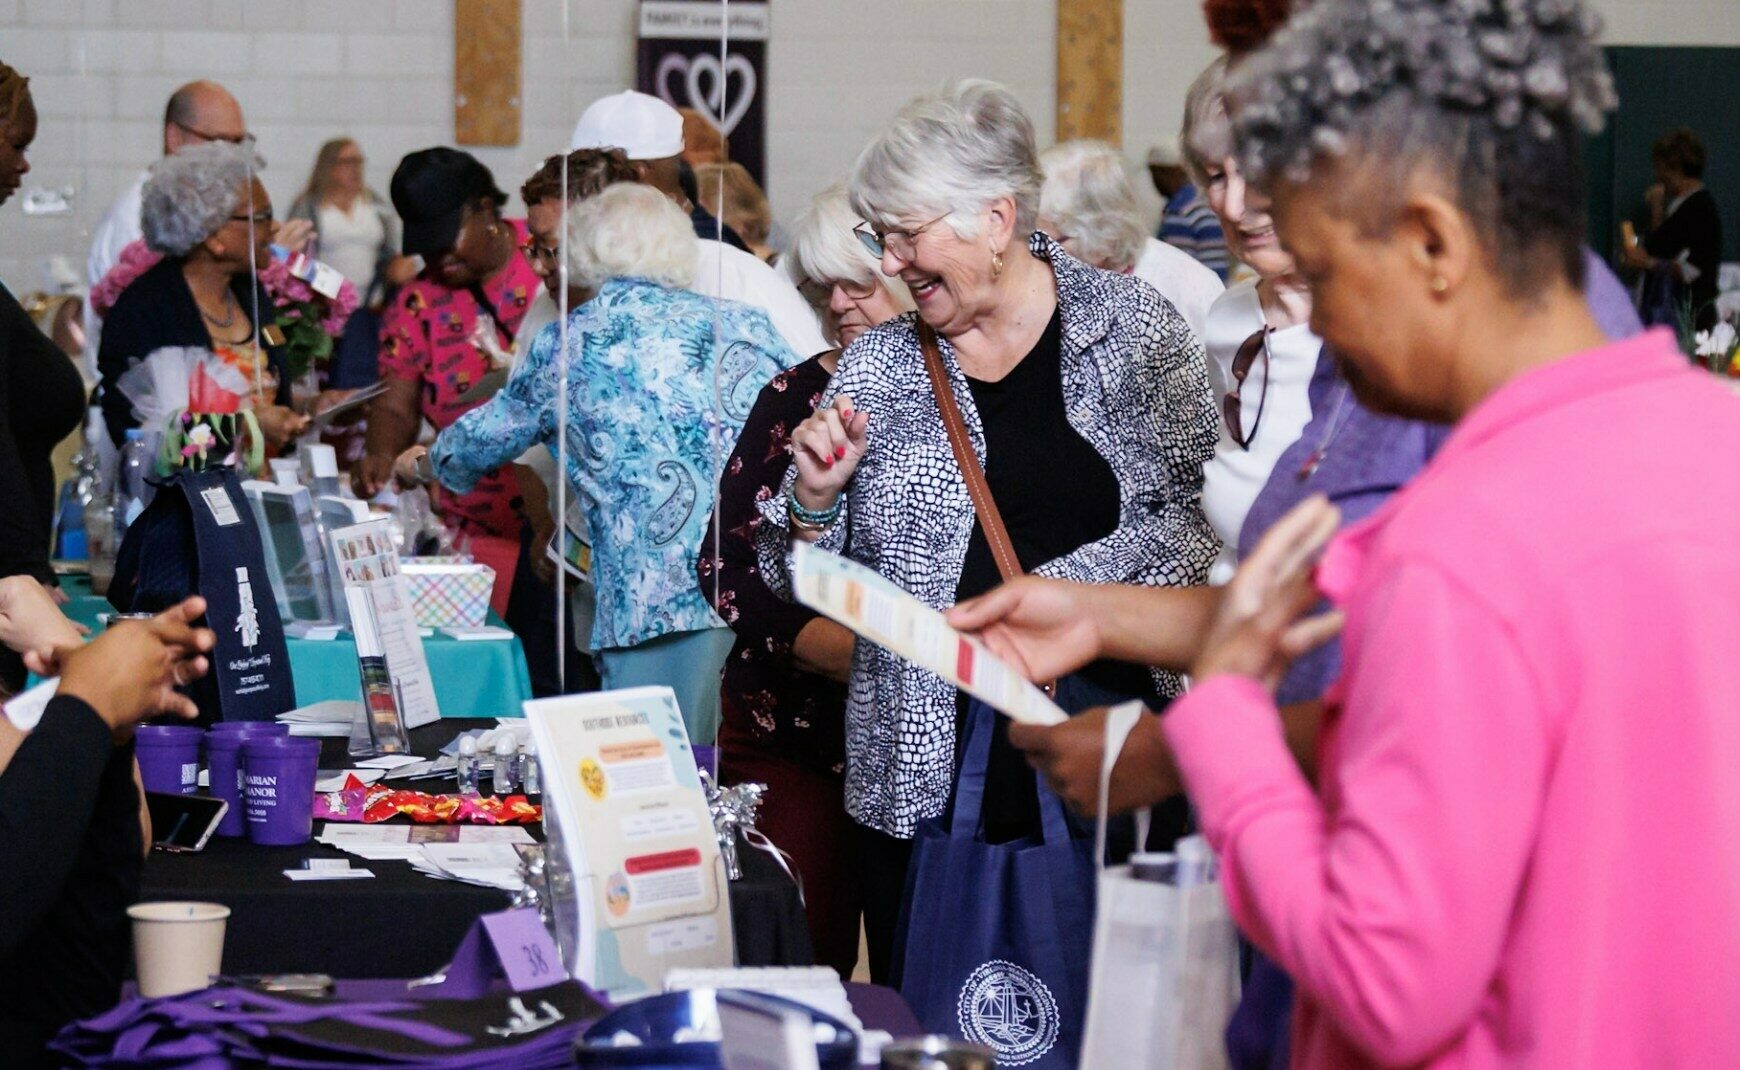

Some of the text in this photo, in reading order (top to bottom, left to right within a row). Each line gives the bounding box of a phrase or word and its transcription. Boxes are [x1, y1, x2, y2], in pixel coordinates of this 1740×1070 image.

[703, 14, 763, 31] eveything
[522, 943, 550, 978] 38
[963, 995, 971, 1014] CITY
[968, 980, 978, 992] OF
[1032, 982, 1053, 1016] VIRGINIA
